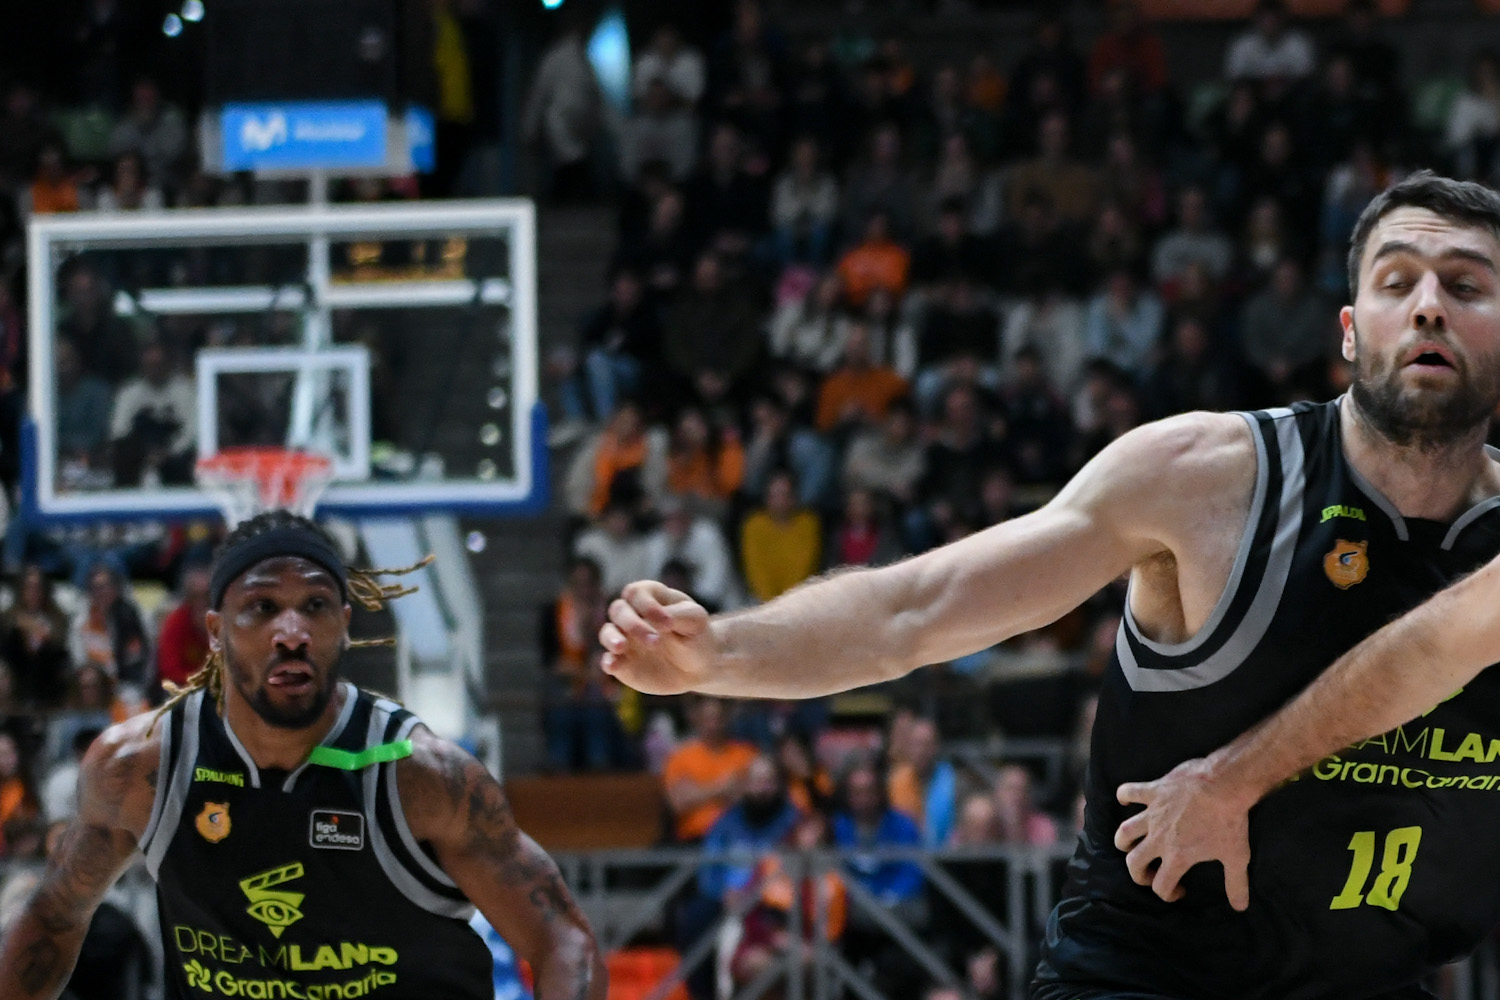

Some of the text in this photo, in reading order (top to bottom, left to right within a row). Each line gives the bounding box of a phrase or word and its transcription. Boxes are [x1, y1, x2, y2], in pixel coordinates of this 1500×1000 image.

[194, 767, 245, 787] SPALDING
[315, 821, 338, 834] liga
[315, 832, 360, 845] endesa
[1329, 825, 1423, 912] 18
[174, 925, 398, 972] DREAMLAND
